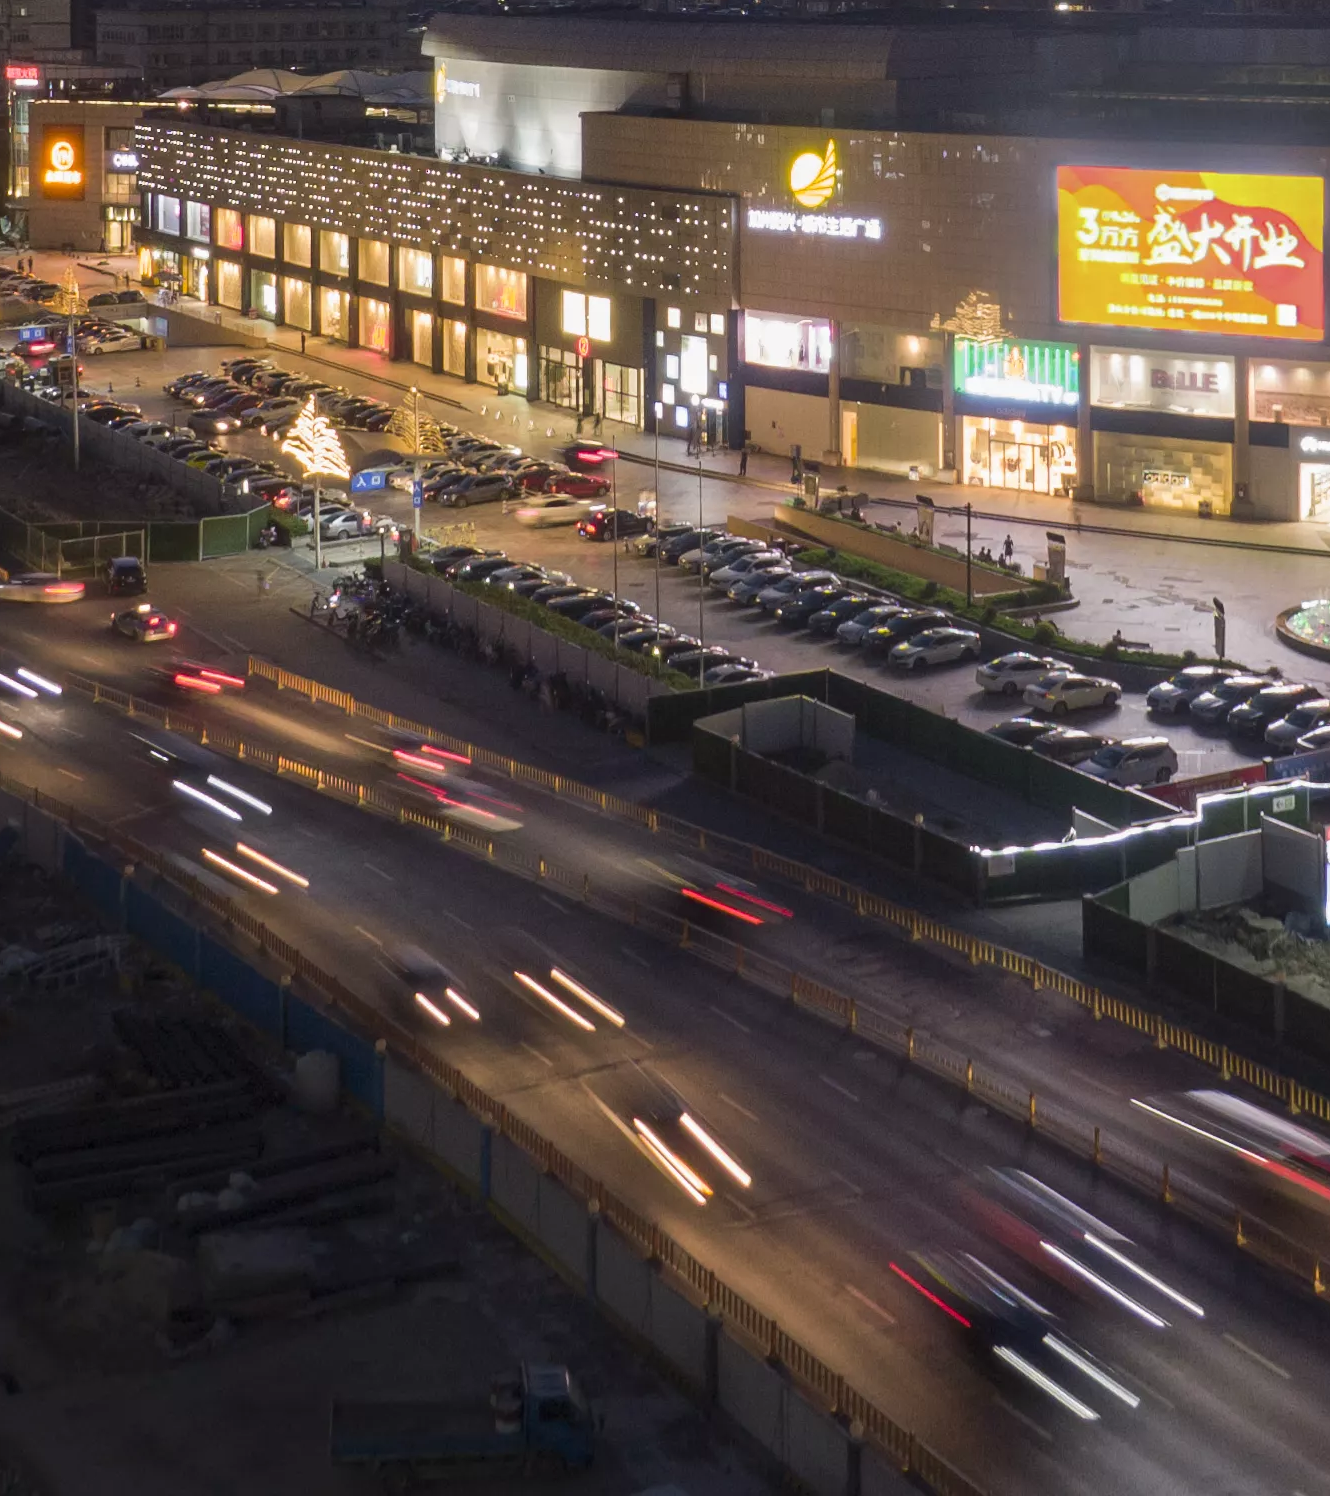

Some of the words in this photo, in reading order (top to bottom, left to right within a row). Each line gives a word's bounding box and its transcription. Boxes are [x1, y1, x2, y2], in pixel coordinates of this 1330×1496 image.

[1142, 205, 1305, 271] 盛大开业
[356, 475, 381, 488] 入口
